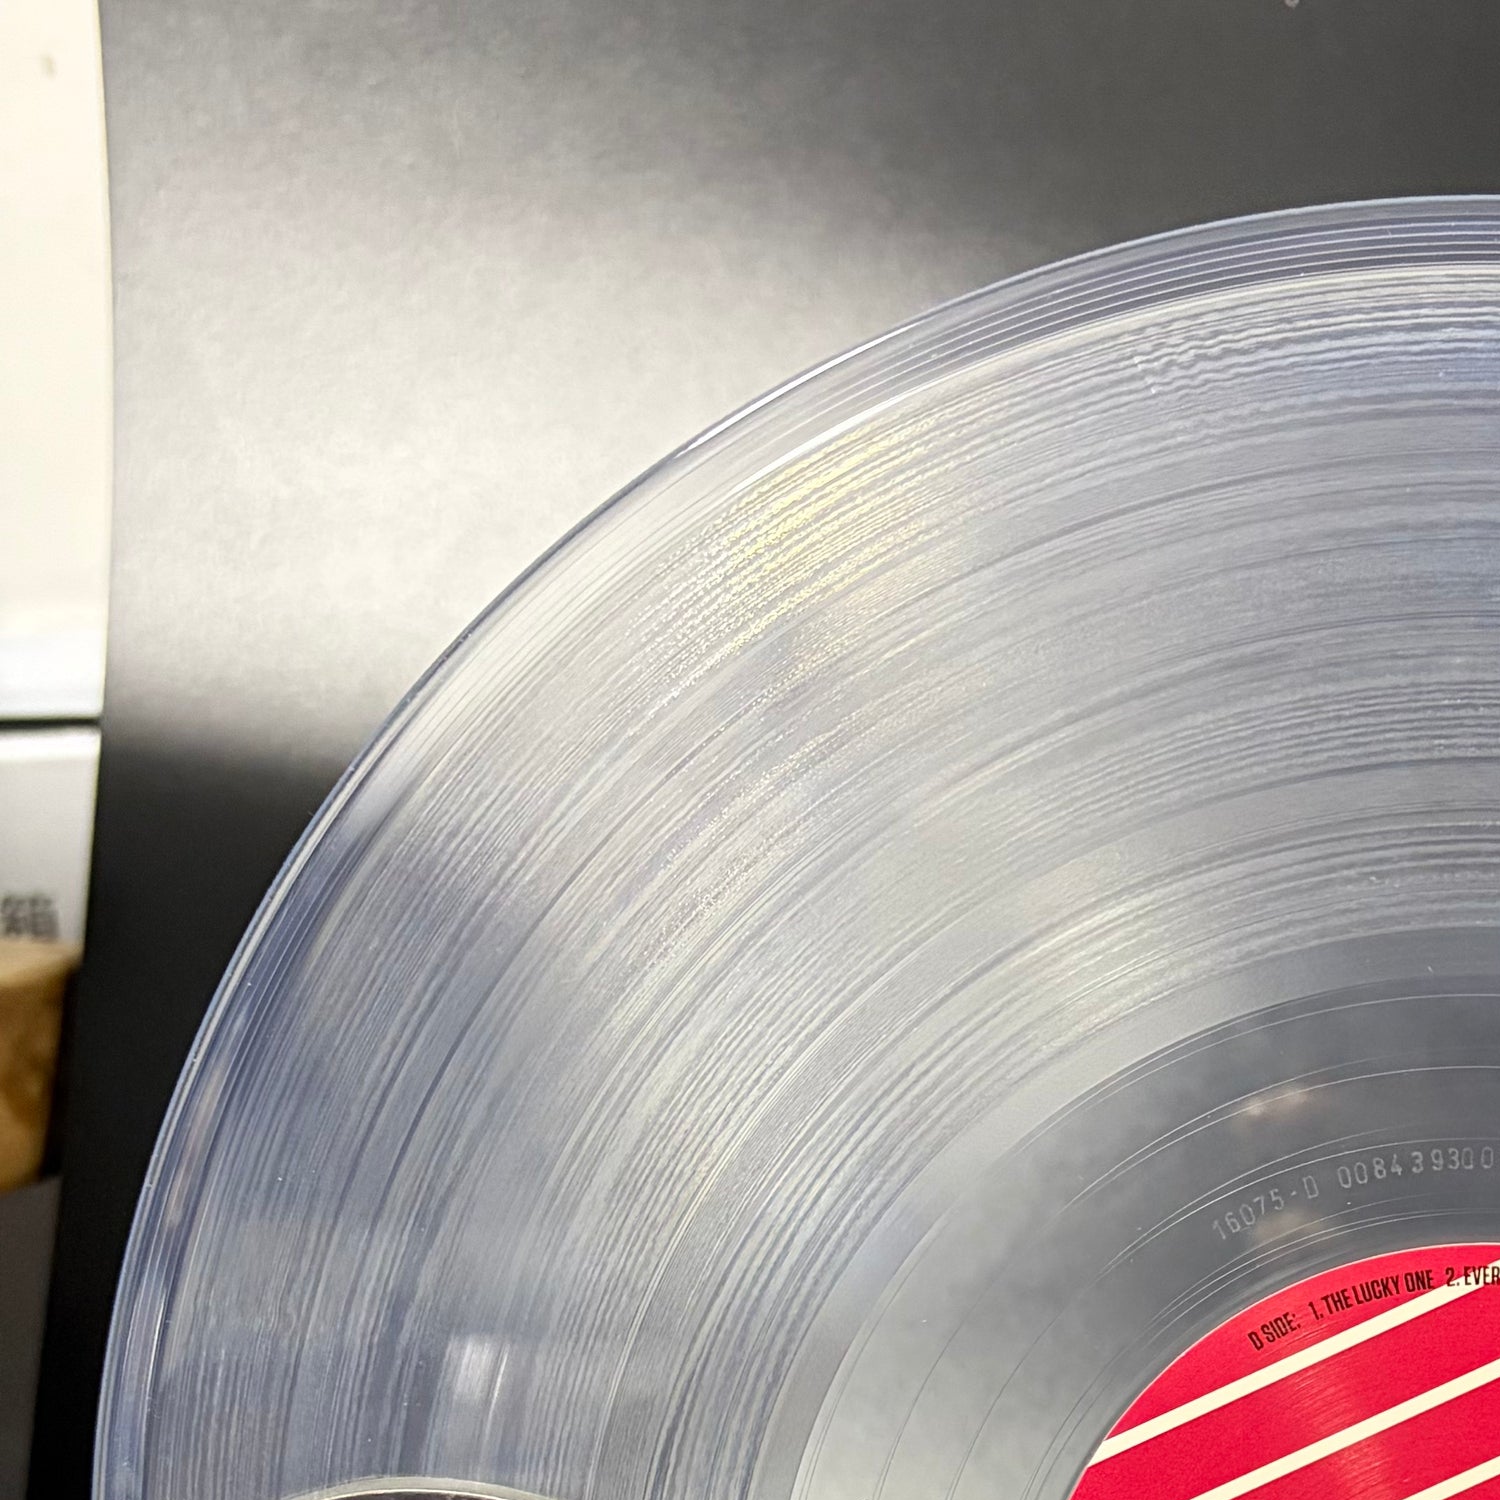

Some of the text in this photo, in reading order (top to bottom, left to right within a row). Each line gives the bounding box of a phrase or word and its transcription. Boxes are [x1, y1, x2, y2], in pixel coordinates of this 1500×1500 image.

[1247, 1331, 1264, 1351] D
[1261, 1311, 1302, 1344] SIDE:
[1308, 1301, 1324, 1321] 1.
[1321, 1288, 1353, 1315] THE
[1351, 1274, 1400, 1305] LUCKY
[1404, 1269, 1435, 1293] ONE
[1445, 1266, 1460, 1287] 2.
